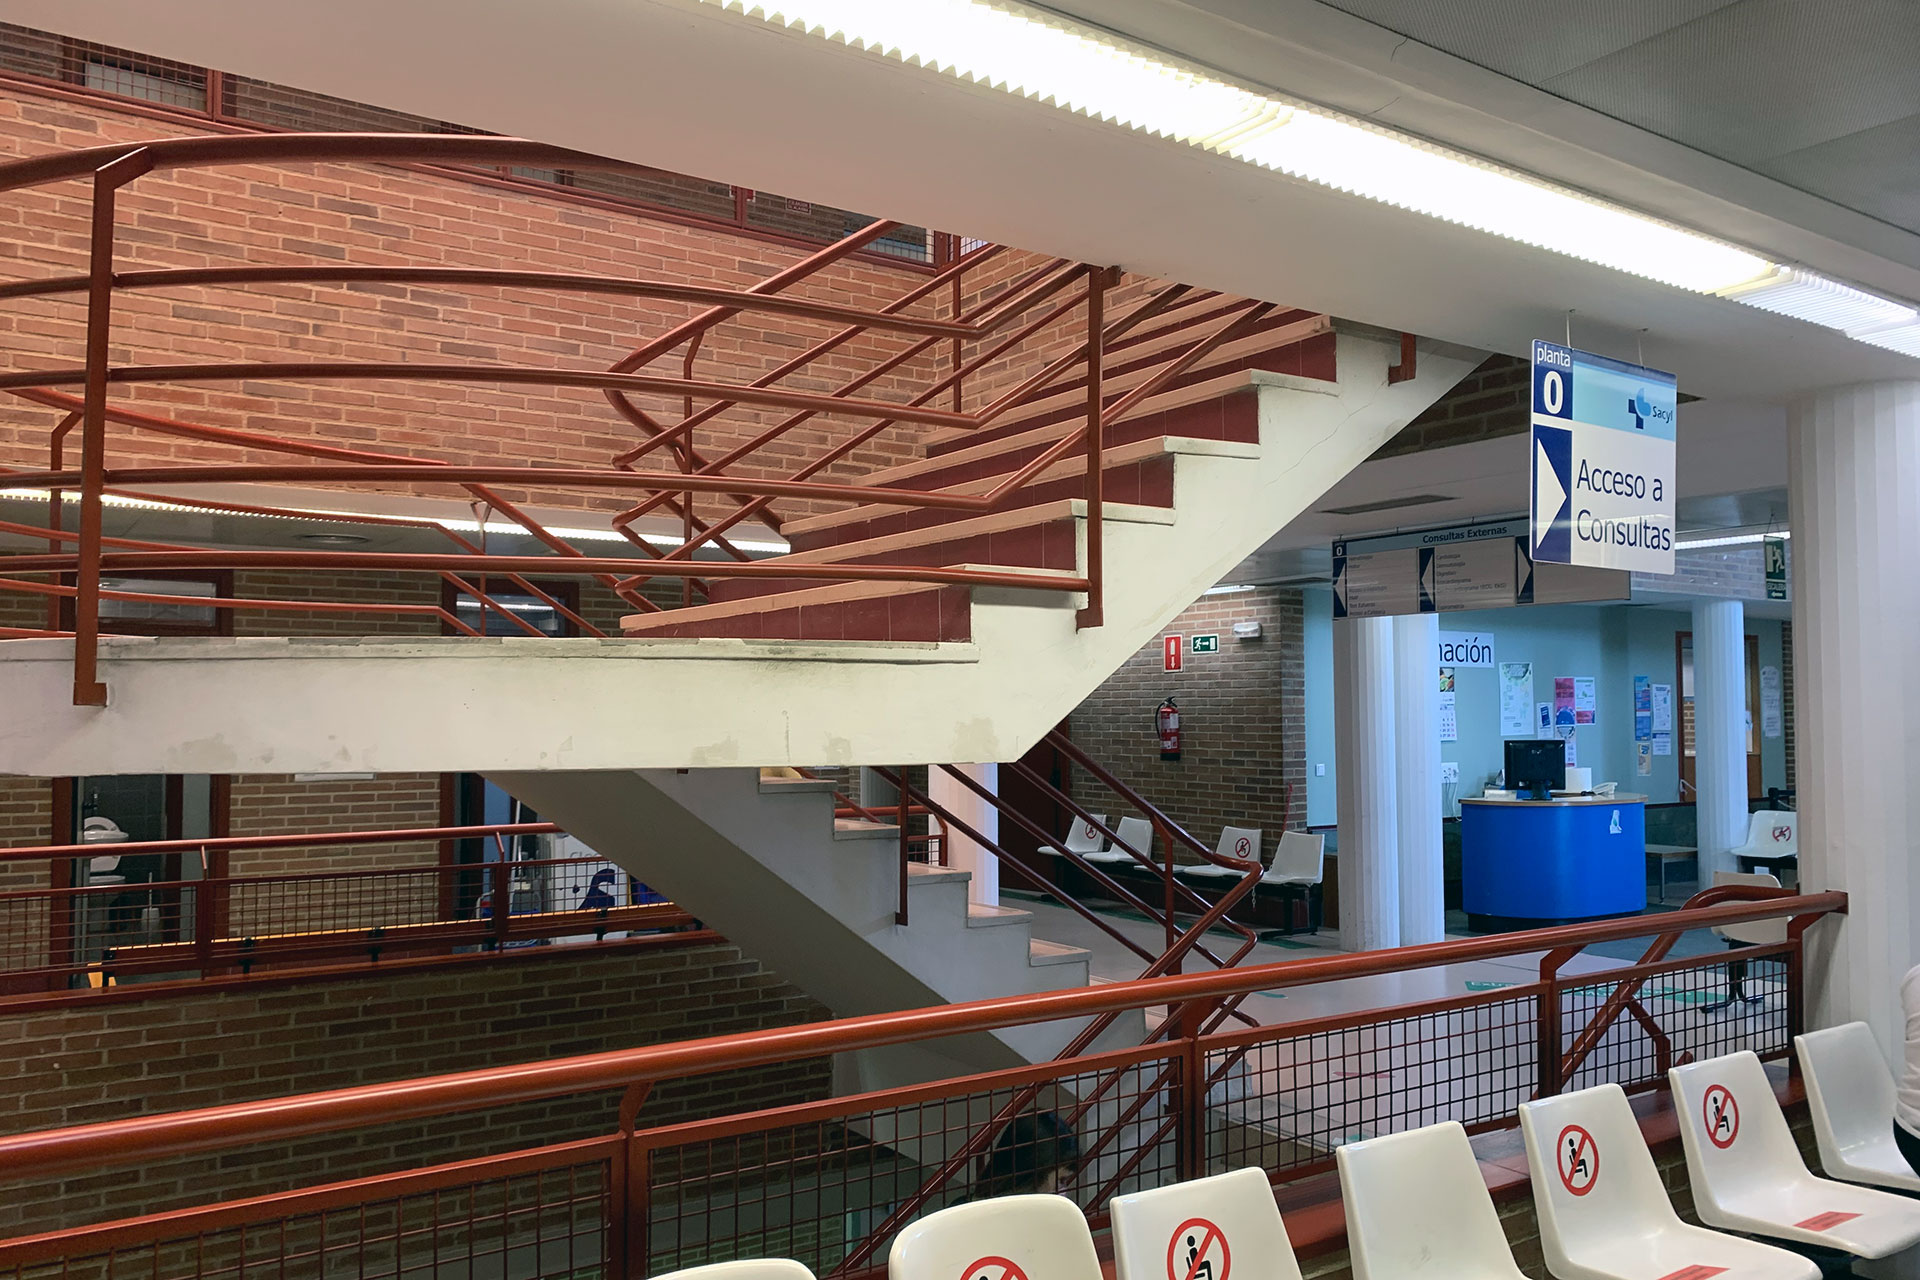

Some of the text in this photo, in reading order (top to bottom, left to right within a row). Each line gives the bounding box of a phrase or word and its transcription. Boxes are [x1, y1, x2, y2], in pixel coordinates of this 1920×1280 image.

[1537, 346, 1571, 367] planta
[1543, 370, 1564, 415] 0
[1652, 405, 1673, 423] Sacyl
[1576, 458, 1663, 502] Acceso a
[1422, 526, 1508, 544] Consultas Externas
[1576, 509, 1671, 551] Consultas
[1336, 546, 1343, 556] 0
